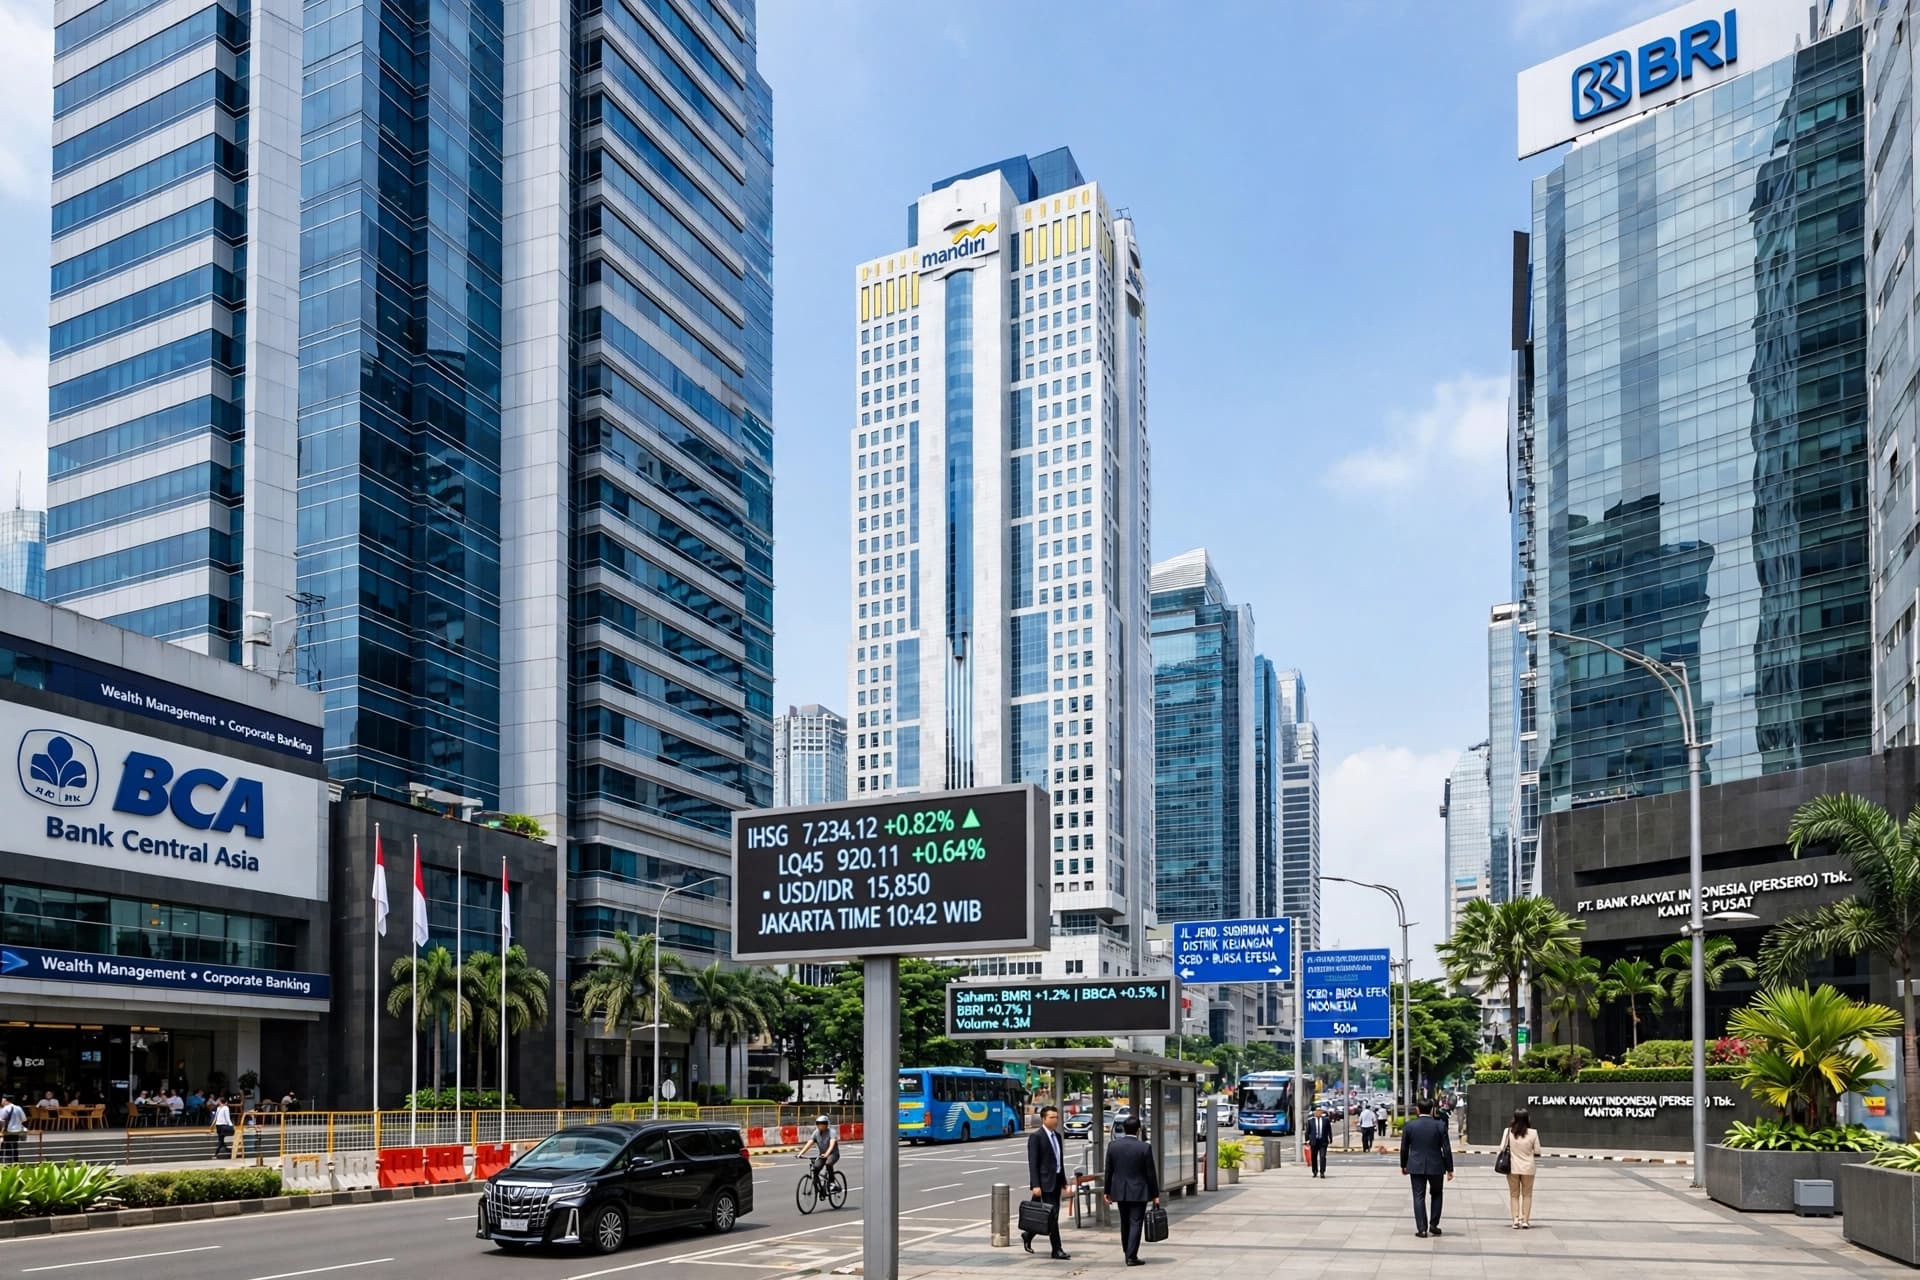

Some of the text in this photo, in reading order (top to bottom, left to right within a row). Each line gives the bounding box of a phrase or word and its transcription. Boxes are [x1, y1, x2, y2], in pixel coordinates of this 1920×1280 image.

[1638, 8, 1737, 97] BRI
[922, 237, 985, 268] mandiri
[101, 683, 313, 754] Wealth Management Corporate Banking
[112, 750, 265, 839] BCA
[46, 815, 260, 872] Bank Central Asia
[747, 809, 955, 849] IHSG 7,234.12 +0.82%
[778, 838, 986, 878] LQ45 920.11 +0.64%
[778, 872, 931, 905] USD/IDR 15,850
[1577, 870, 1853, 912] PT. BANK RAKYAT INONESIA (PERSERO) Tbk.
[1657, 896, 1754, 917] KANTR PUSAT
[758, 899, 983, 935] JAKARTA TIME 10:42 WIB
[41, 955, 311, 993] Wealth Management Corporate Banking
[956, 989, 998, 1003] Saham:
[1001, 989, 1031, 1002] BMRI
[1035, 988, 1070, 1001] +1.2%
[1082, 987, 1117, 1000] BBCA
[1119, 986, 1158, 999] +0.5%
[957, 1004, 984, 1016] BBRI
[987, 1003, 1023, 1016] +0.7%
[956, 1017, 1031, 1029] Volume 4.3M
[1528, 1095, 1736, 1108] PT. BANK RAKYAT INDONESIA (PERSE) Tbk.
[1584, 1107, 1657, 1118] KANTOR PUSAT
